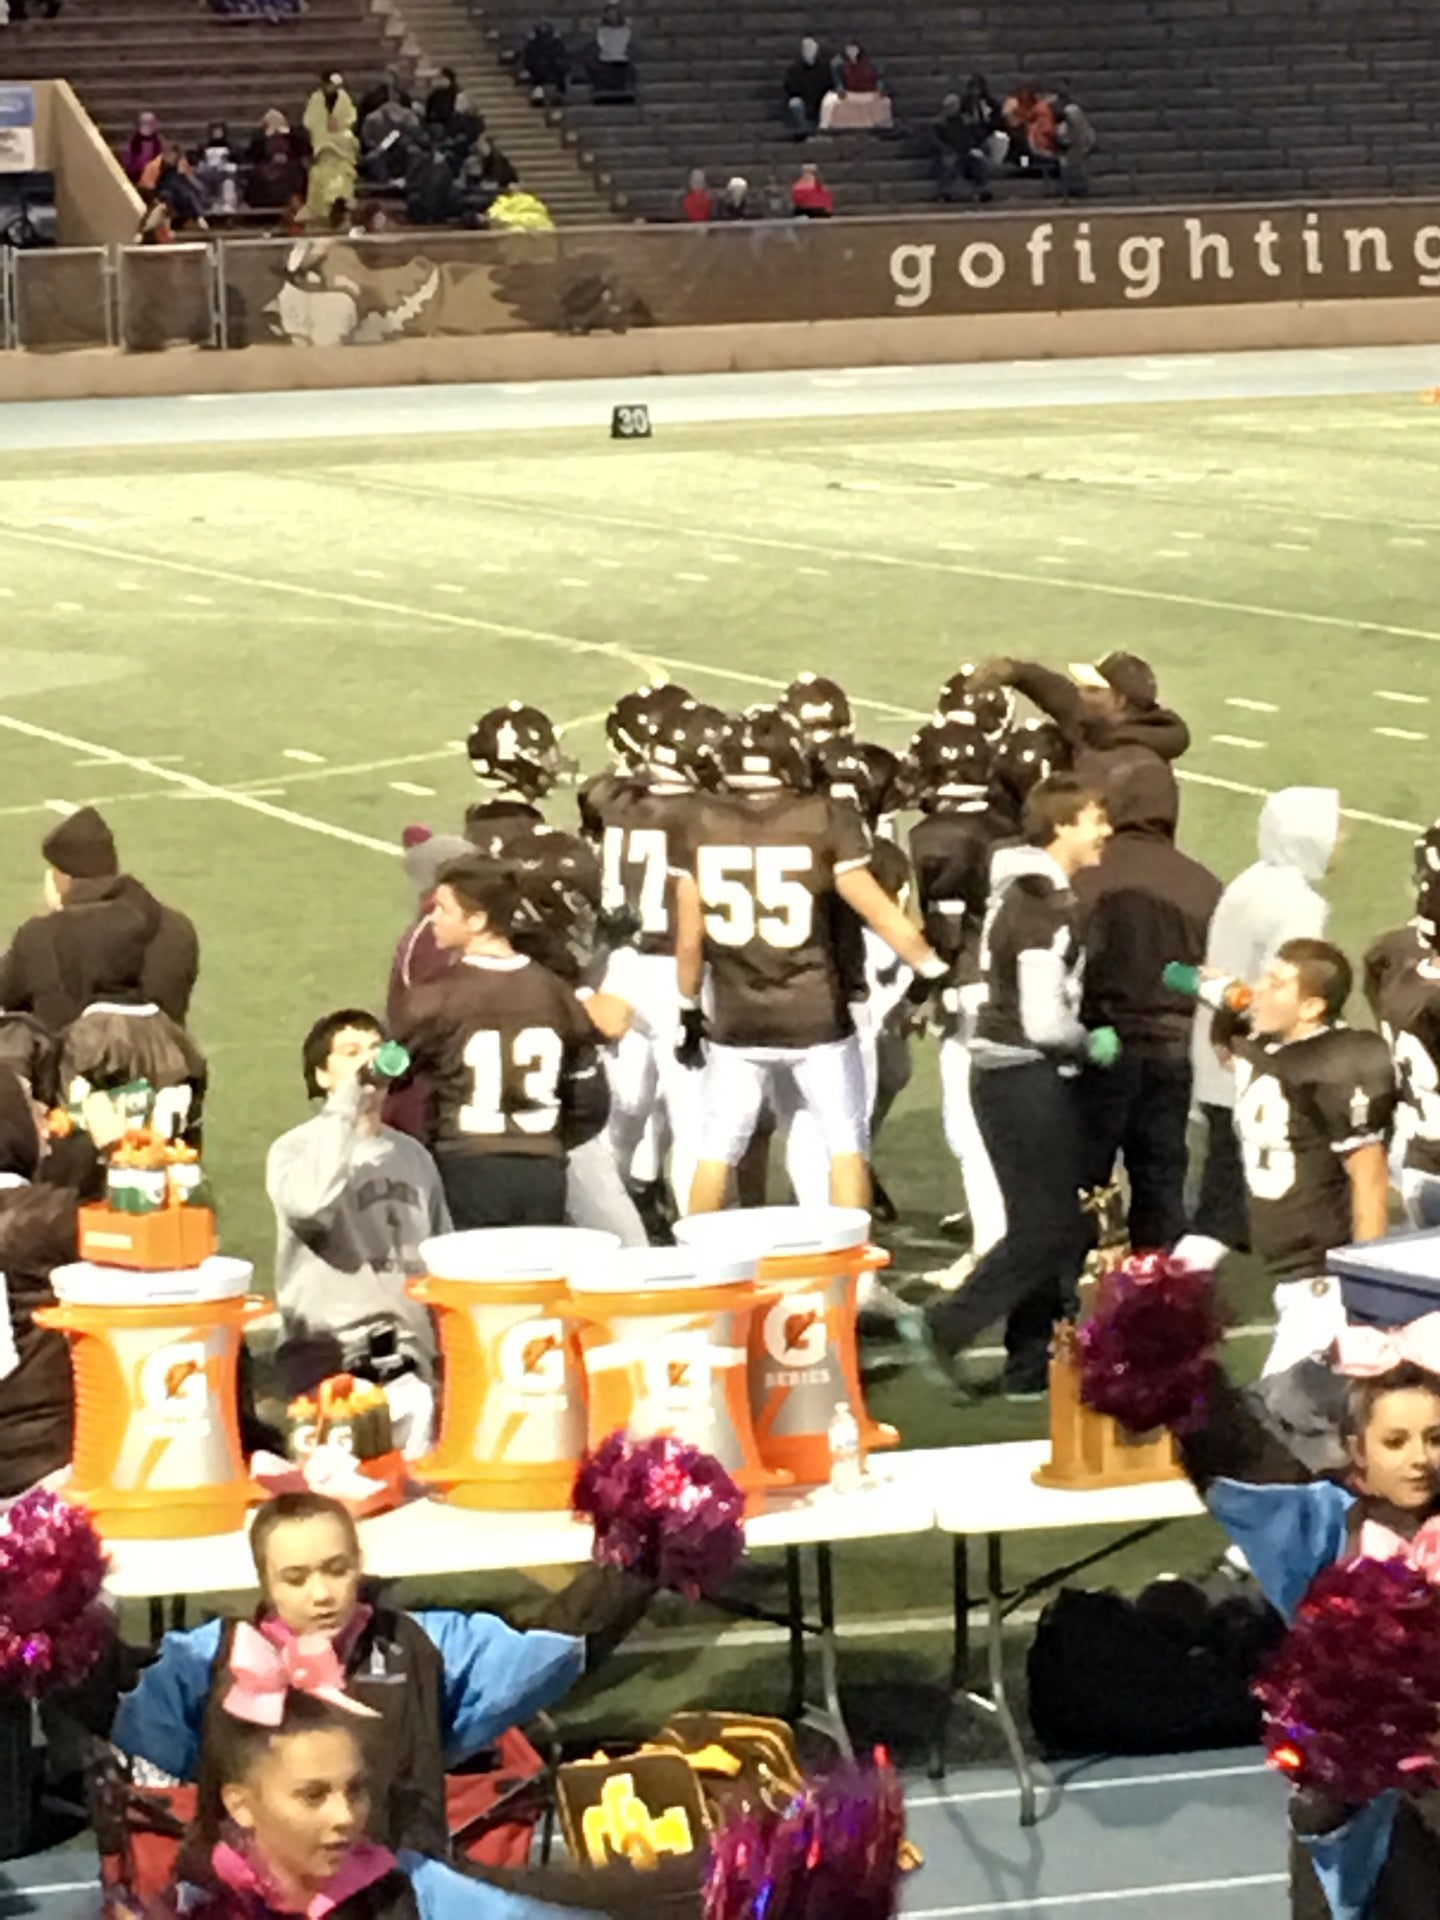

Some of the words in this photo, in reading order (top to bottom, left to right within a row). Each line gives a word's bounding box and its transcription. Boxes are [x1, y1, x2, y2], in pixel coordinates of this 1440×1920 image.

[618, 408, 648, 434] 30
[698, 845, 813, 948] 55
[459, 1028, 563, 1134] 13
[500, 1318, 564, 1392] G
[764, 1291, 827, 1367] G
[143, 1342, 208, 1416] G
[764, 1368, 832, 1388] SERIES
